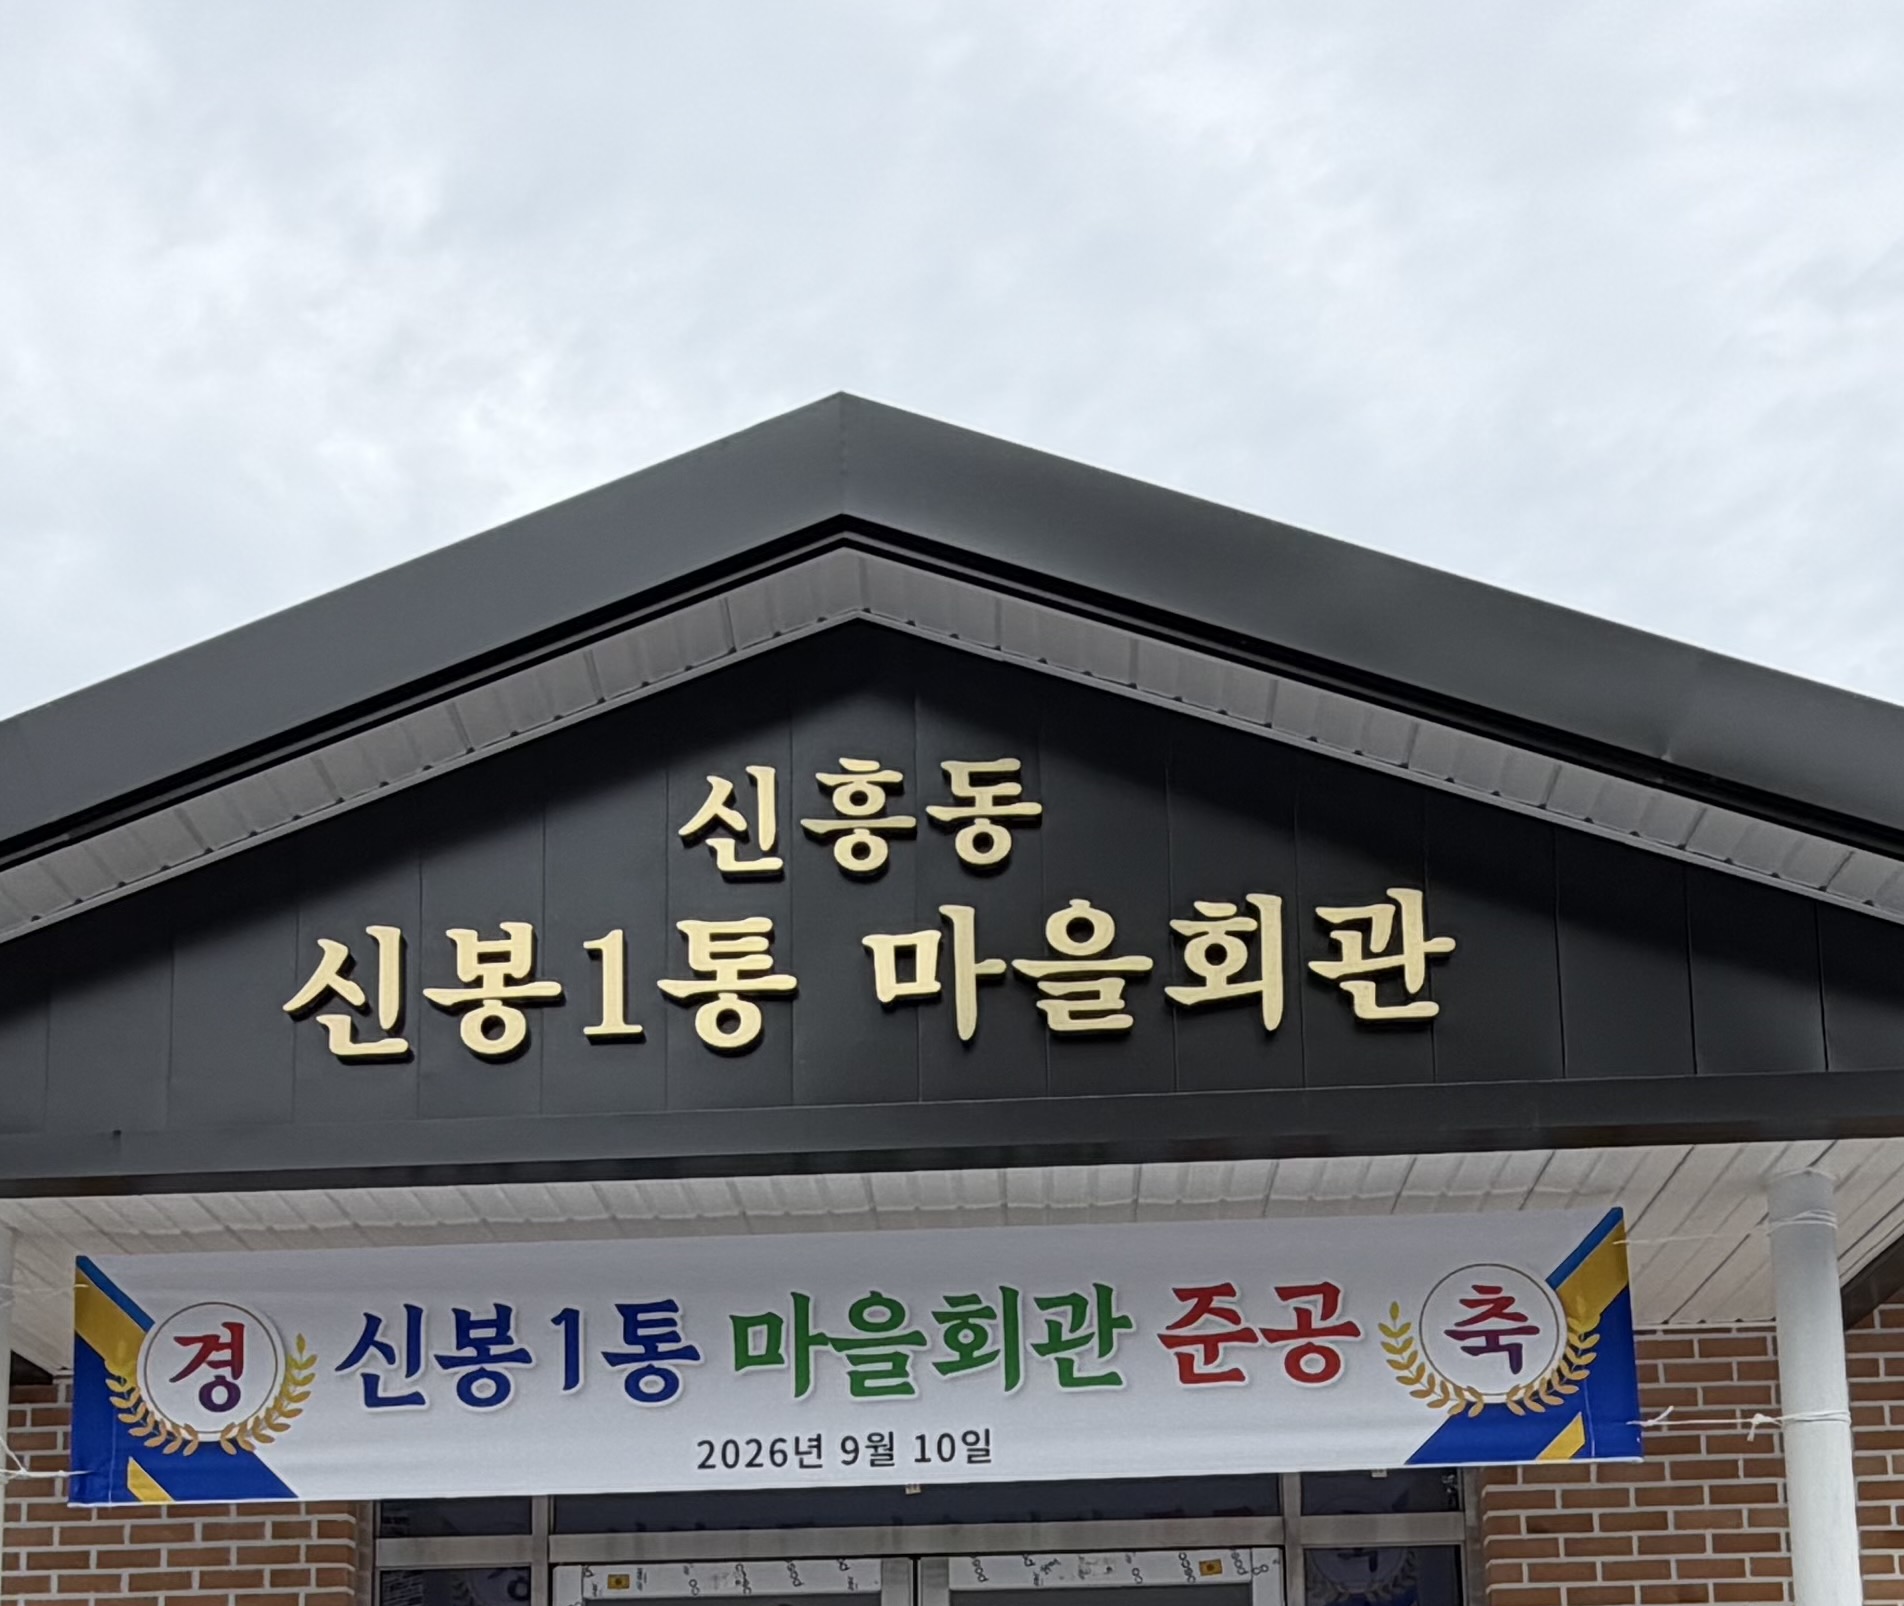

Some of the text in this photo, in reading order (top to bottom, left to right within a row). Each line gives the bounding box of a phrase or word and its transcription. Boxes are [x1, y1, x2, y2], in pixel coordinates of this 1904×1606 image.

[679, 757, 1043, 877] 신흥동
[281, 888, 1456, 1060] 신봉1통 마을회관
[169, 1321, 246, 1414] 경
[334, 1282, 1366, 1409] 신봉1통 마을회관 준공
[1444, 1284, 1541, 1374] 축
[696, 1428, 994, 1470] 2026년 9월 10일
